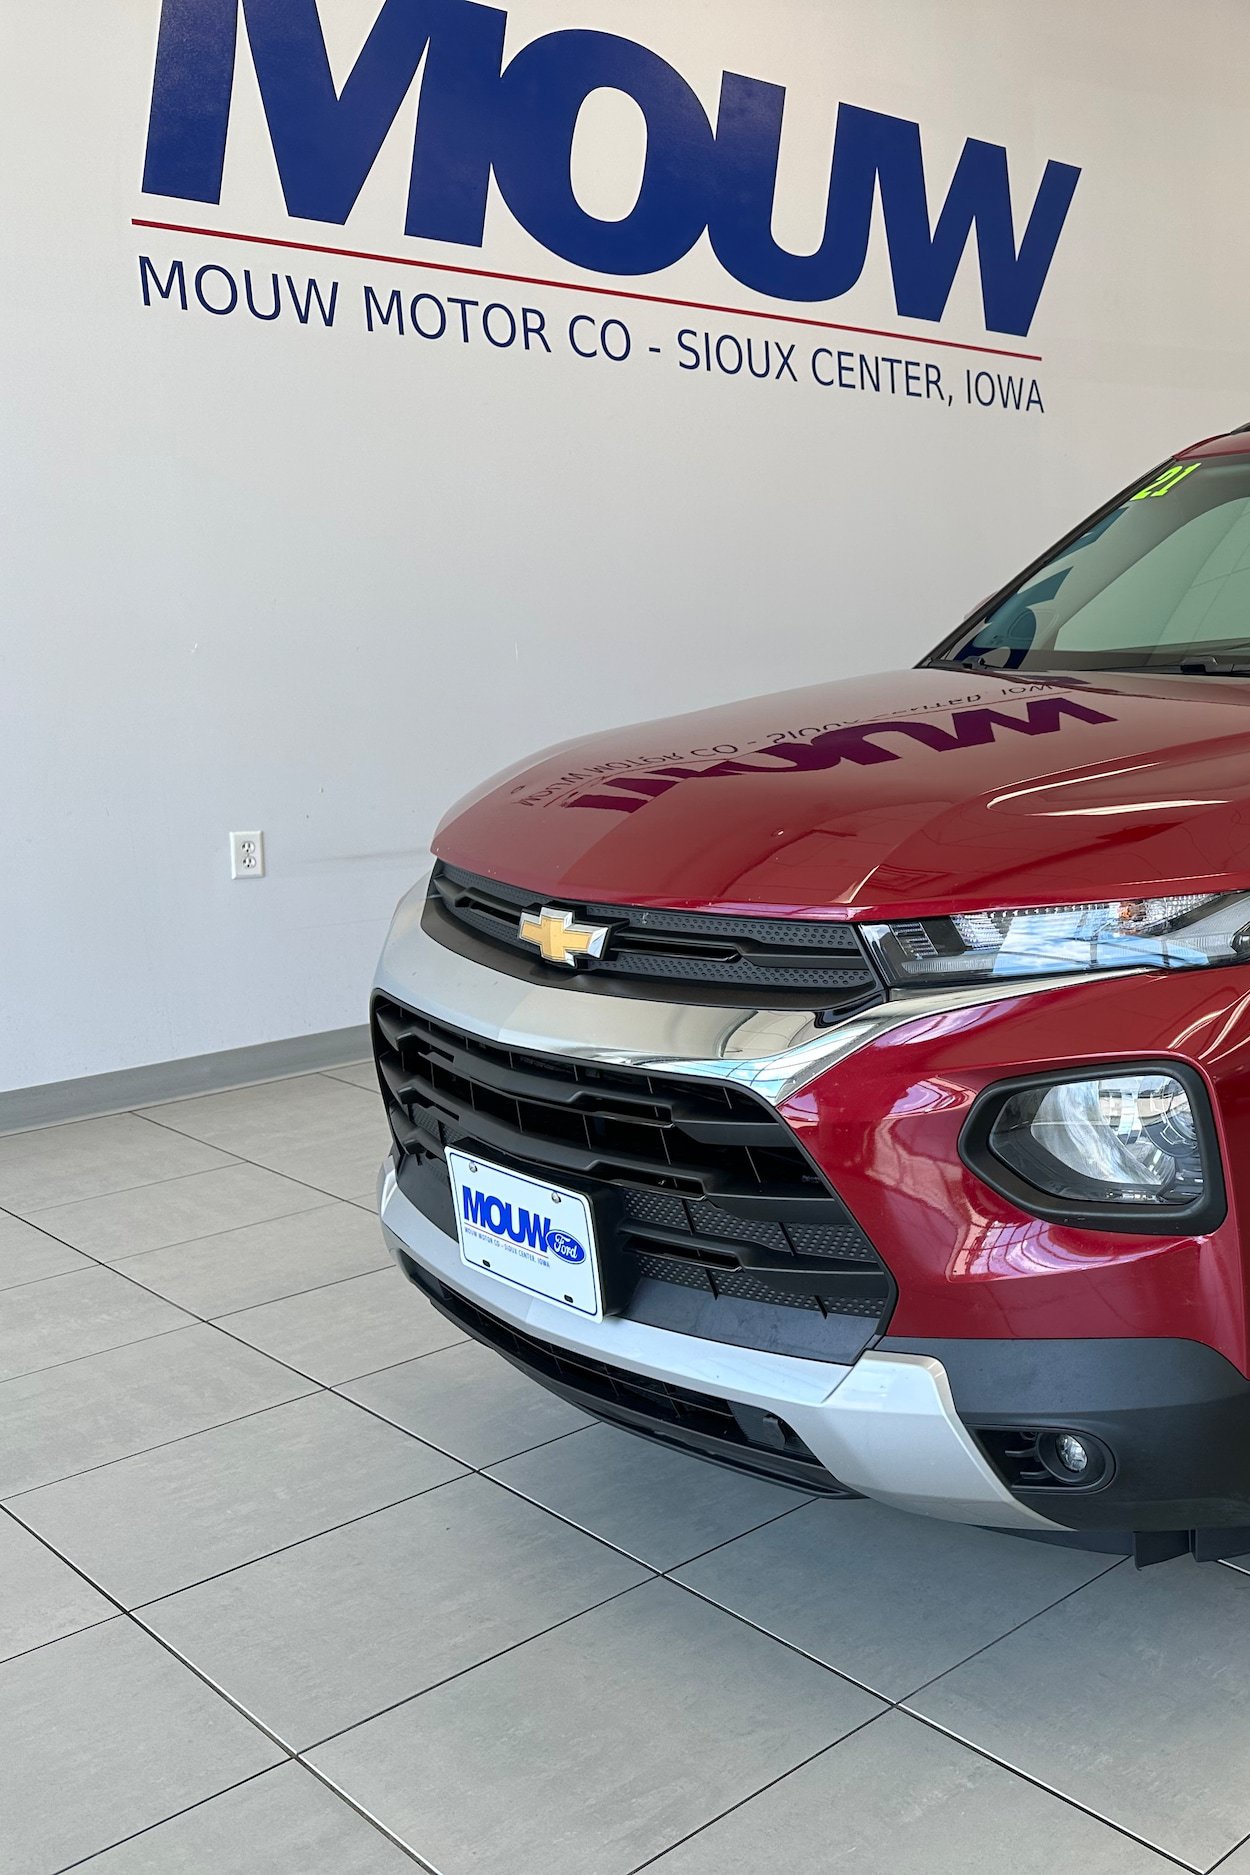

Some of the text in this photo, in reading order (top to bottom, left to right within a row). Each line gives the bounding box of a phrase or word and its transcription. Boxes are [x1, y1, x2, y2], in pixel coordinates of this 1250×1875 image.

[140, 0, 1082, 338] MOUW
[138, 255, 1045, 414] MOUW MOTOR CO - SIOUX CENTER, IOWA
[462, 1184, 551, 1253] MOUW
[553, 1233, 578, 1259] Ford
